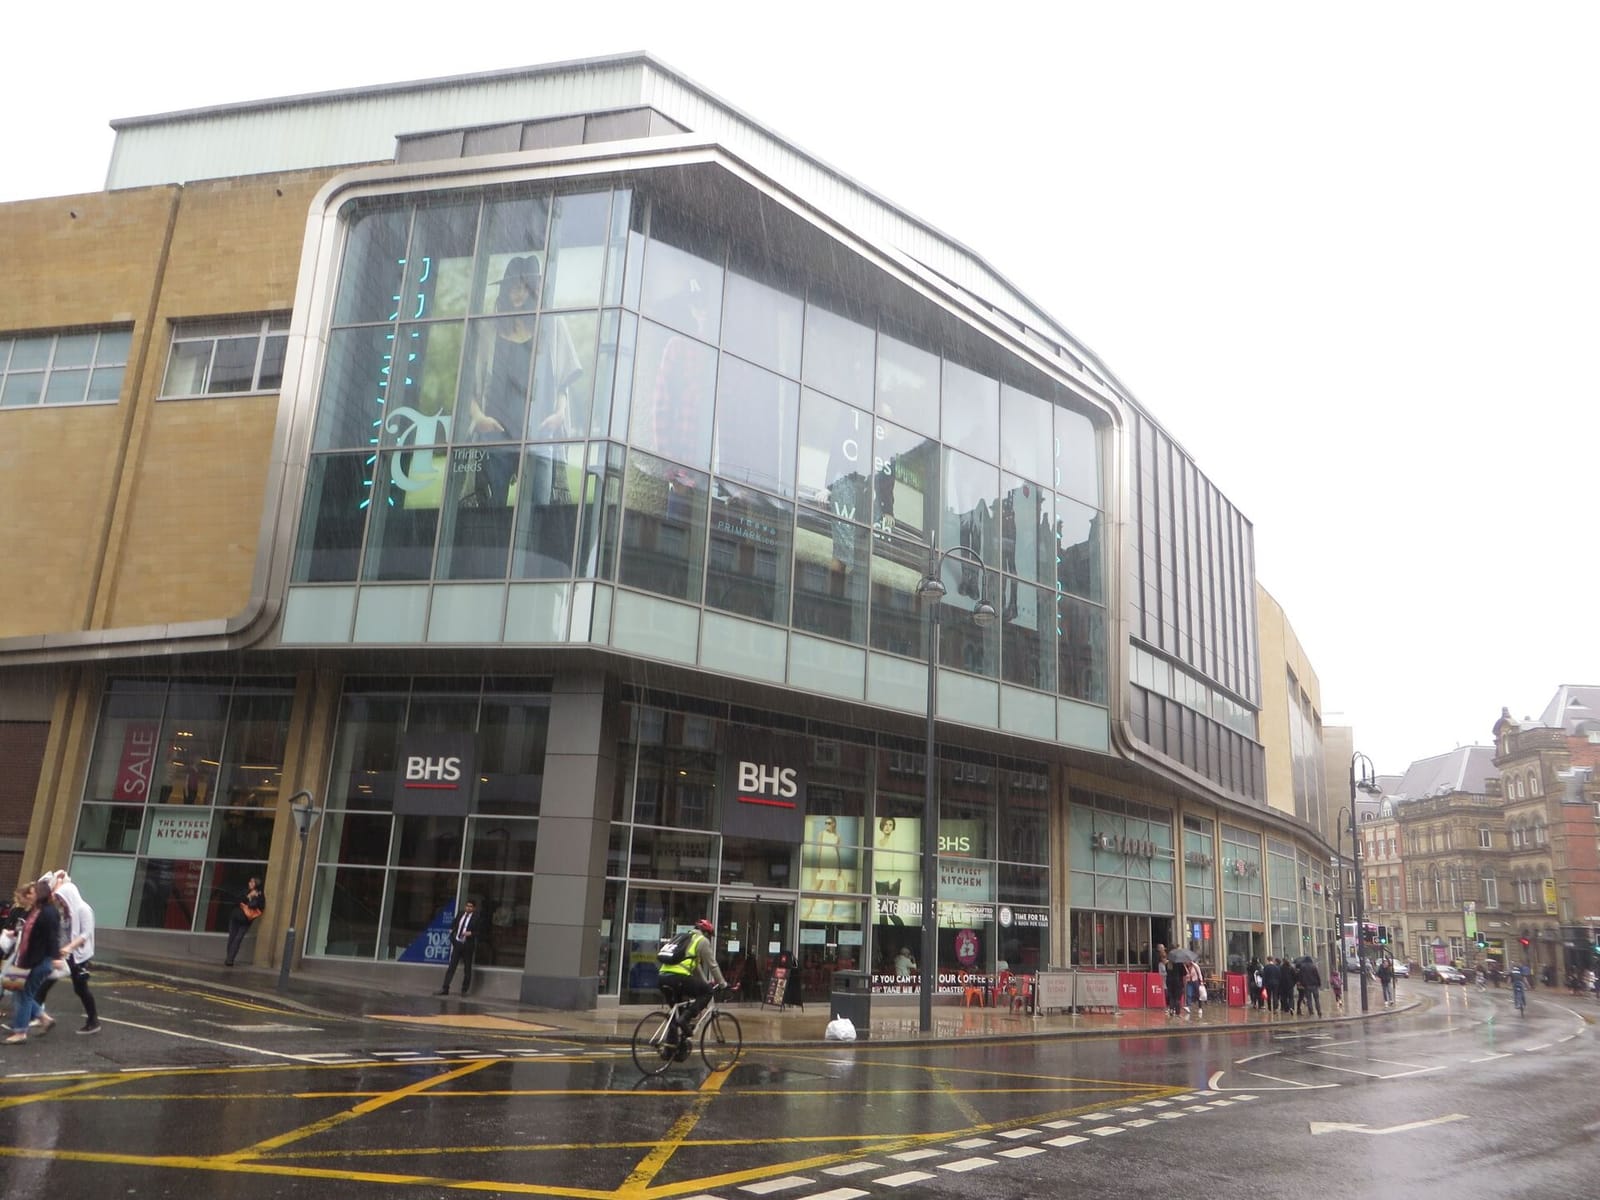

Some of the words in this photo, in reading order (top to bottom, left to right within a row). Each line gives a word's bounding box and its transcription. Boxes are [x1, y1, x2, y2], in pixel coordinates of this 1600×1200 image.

[851, 409, 885, 440] Te
[453, 448, 484, 461] Trinity
[453, 461, 482, 473] Leeds
[123, 728, 154, 794] SALE
[405, 756, 461, 781] BHS
[738, 761, 798, 798] BHS
[158, 819, 175, 828] THE
[178, 820, 209, 828] STREET
[157, 828, 209, 839] KITCHEN
[938, 836, 970, 852] BHS
[941, 865, 954, 873] THE
[941, 875, 982, 887] KITCHEN
[1014, 912, 1027, 921] TIME
[1028, 913, 1038, 921] FOR
[1039, 914, 1049, 922] TEA
[426, 931, 451, 946] 10%
[424, 945, 449, 960] OFF
[959, 942, 975, 957] £2
[872, 974, 879, 983] IF
[880, 974, 895, 983] YOU
[896, 974, 917, 983] CAN'T
[938, 974, 956, 984] OUR
[957, 974, 986, 984] COFFEE
